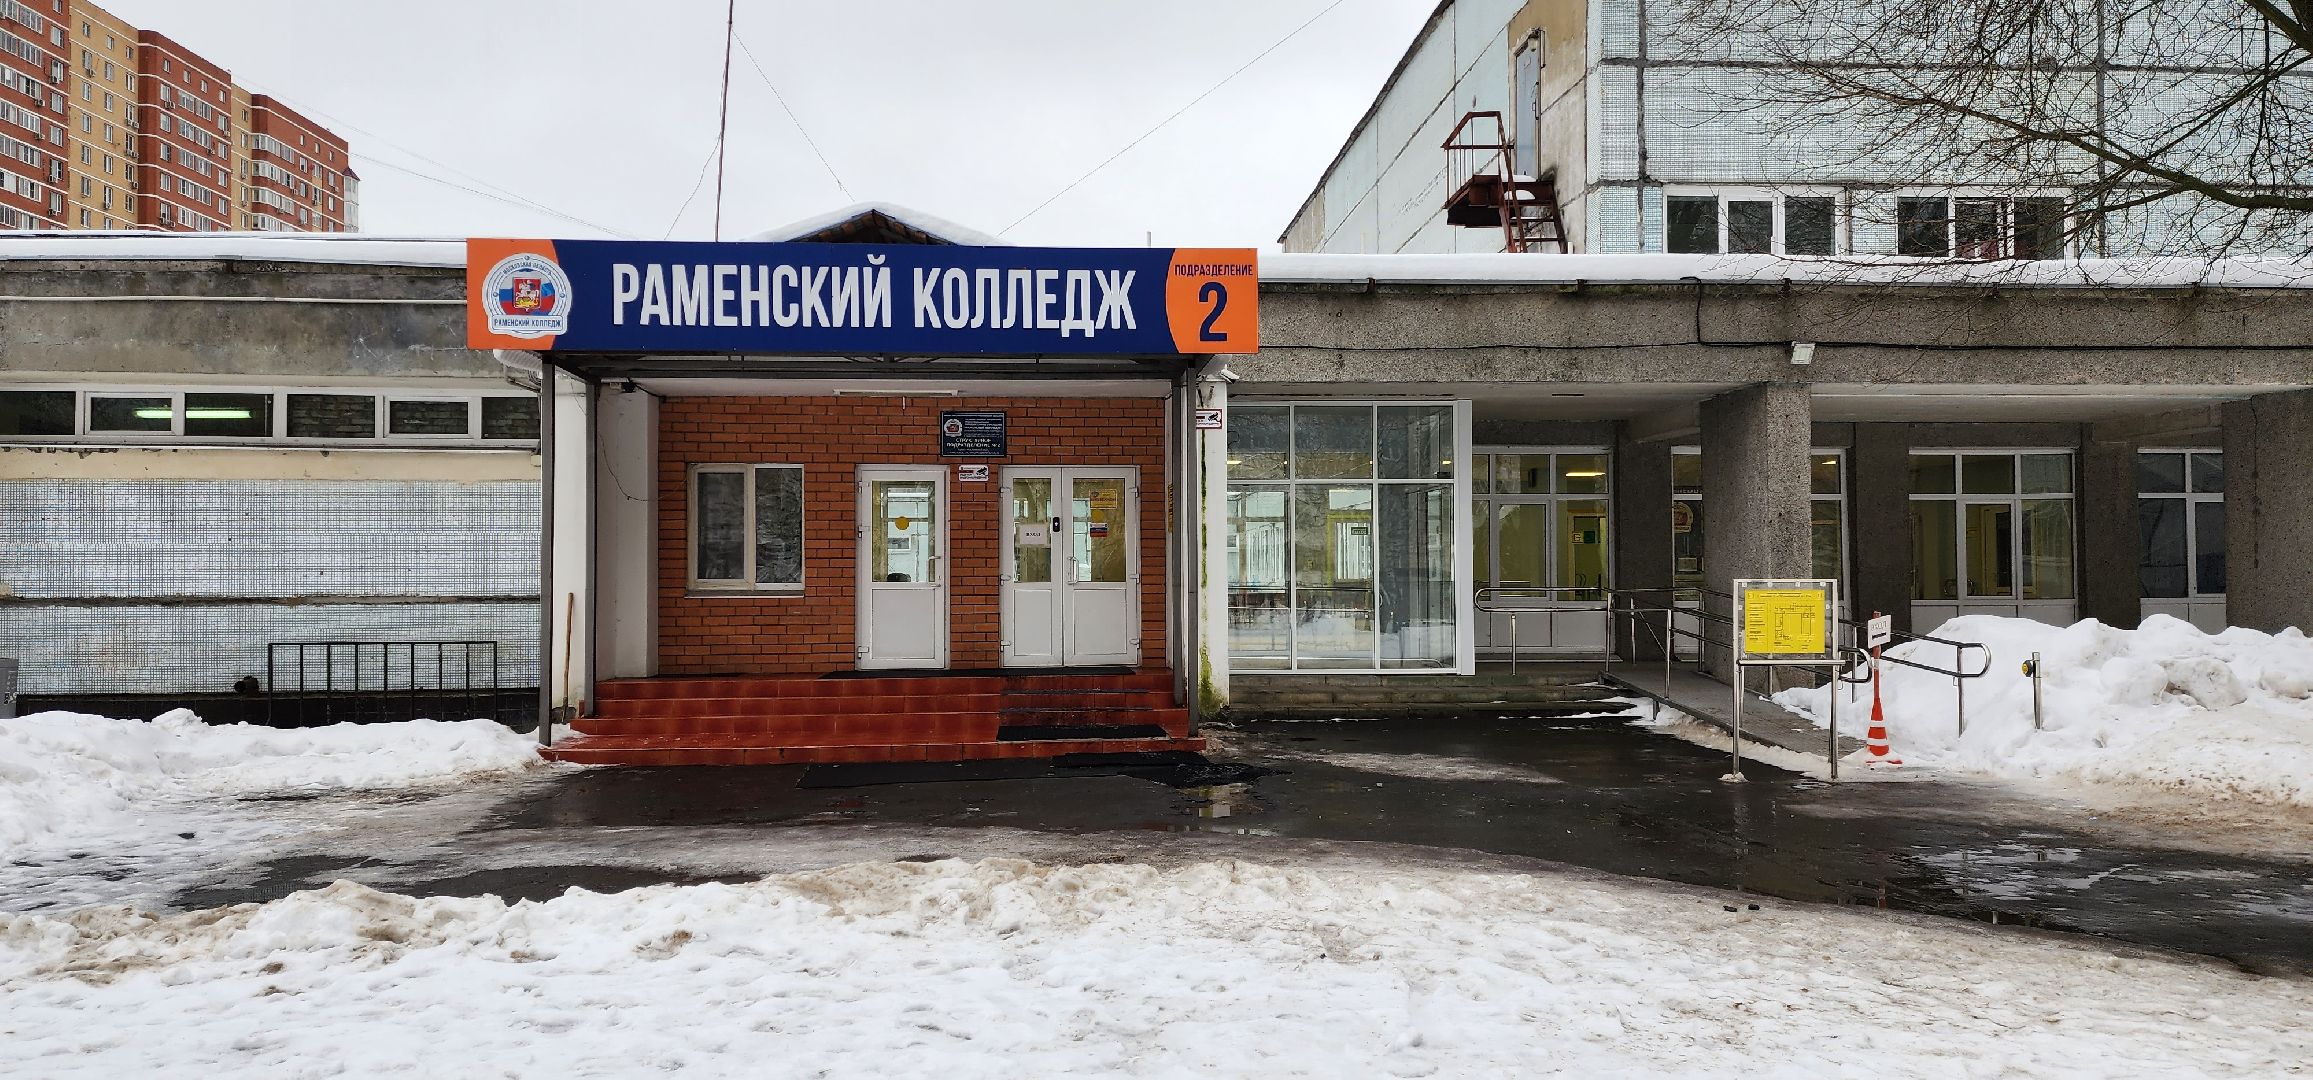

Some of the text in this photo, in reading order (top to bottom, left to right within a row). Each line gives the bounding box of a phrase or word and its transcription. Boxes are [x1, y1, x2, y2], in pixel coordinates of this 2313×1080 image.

[1175, 264, 1253, 277] ПОДРАЗДЕЛЕНИЕ
[613, 254, 1137, 338] РАМЕНСКИЙ КОЛЛЕДЖ
[1199, 281, 1228, 342] 2
[494, 318, 530, 327] РАМЕНСКИЙ
